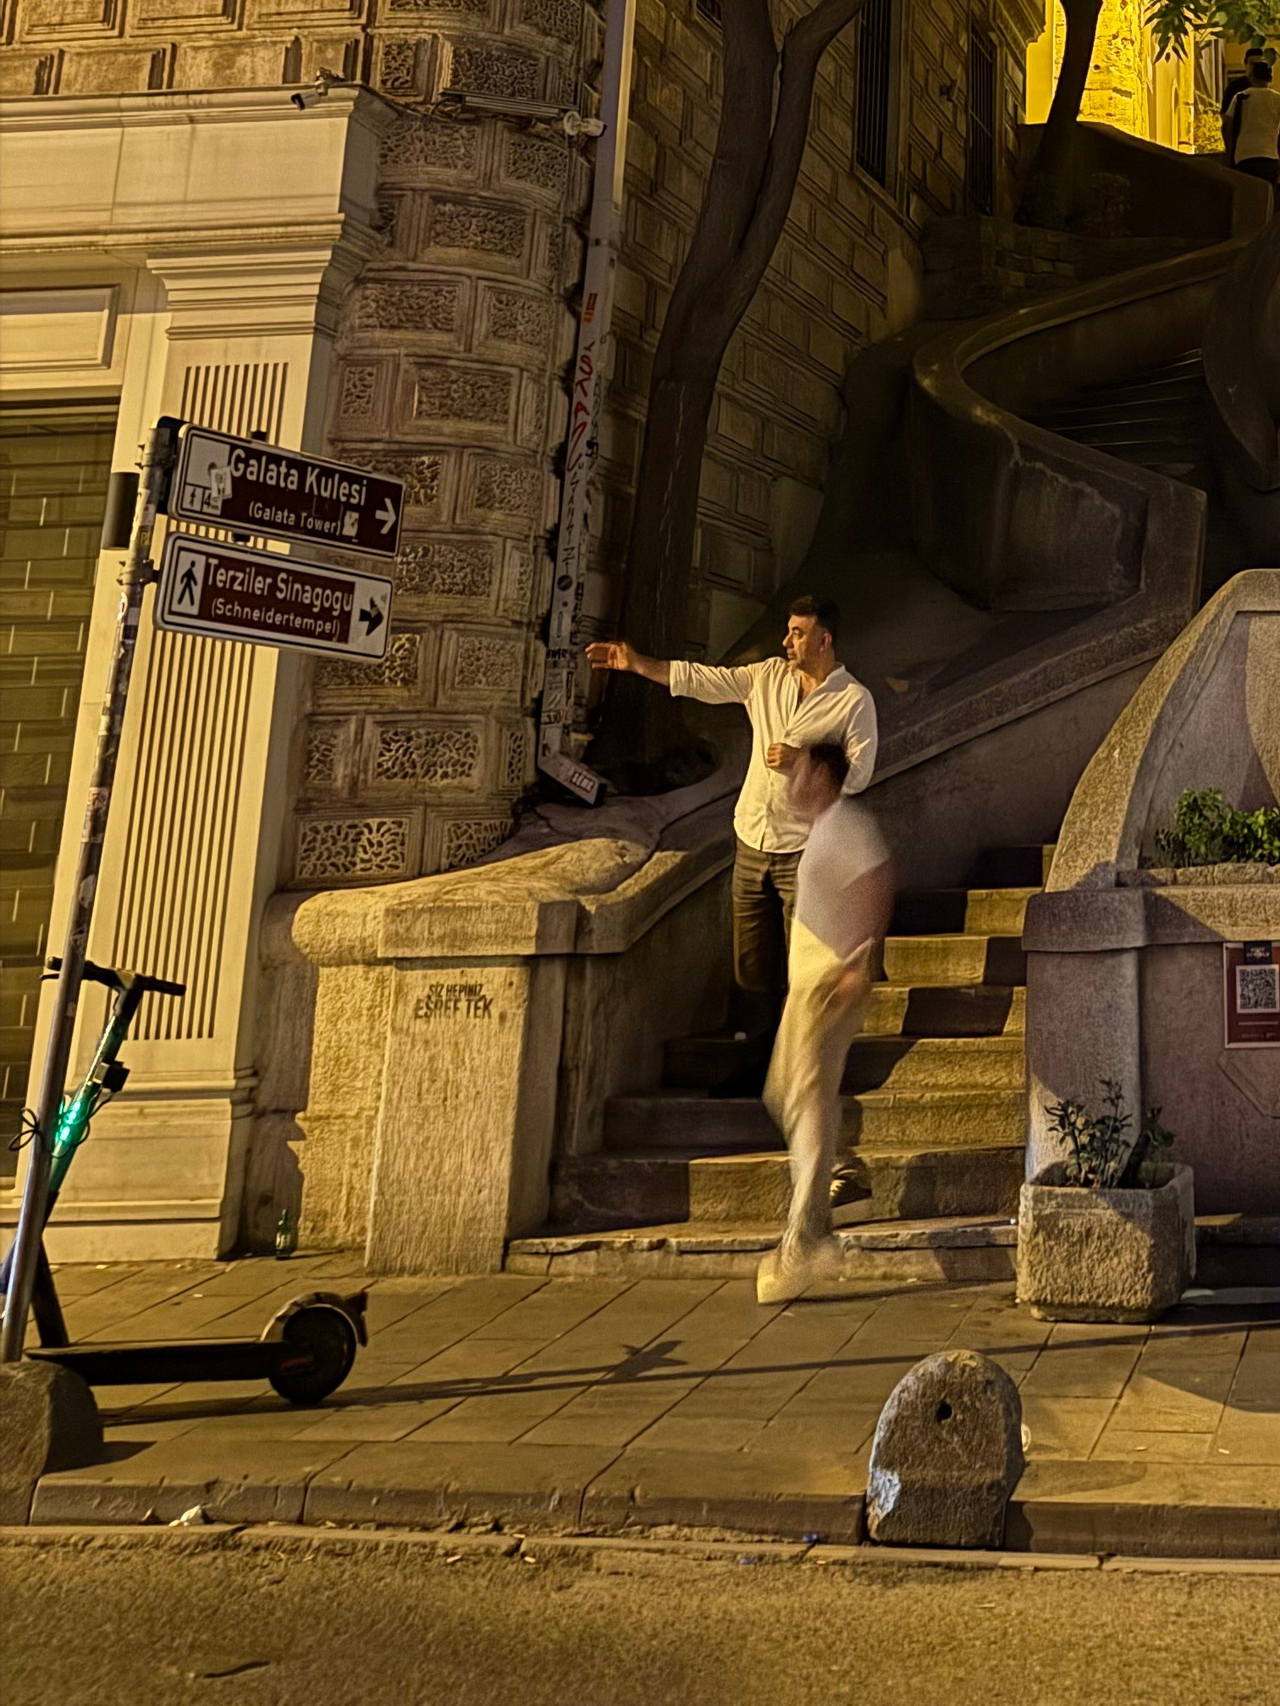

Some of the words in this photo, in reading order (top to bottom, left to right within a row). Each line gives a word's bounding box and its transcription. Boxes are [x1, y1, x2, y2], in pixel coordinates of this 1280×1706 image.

[230, 448, 299, 491] Galata
[304, 467, 367, 506] Kulesi
[249, 500, 296, 526] (Galata
[300, 512, 342, 536] Tower)
[206, 558, 273, 595] Terziler
[276, 572, 352, 616] Sinagogu
[211, 598, 341, 636] (Schneidertempel)
